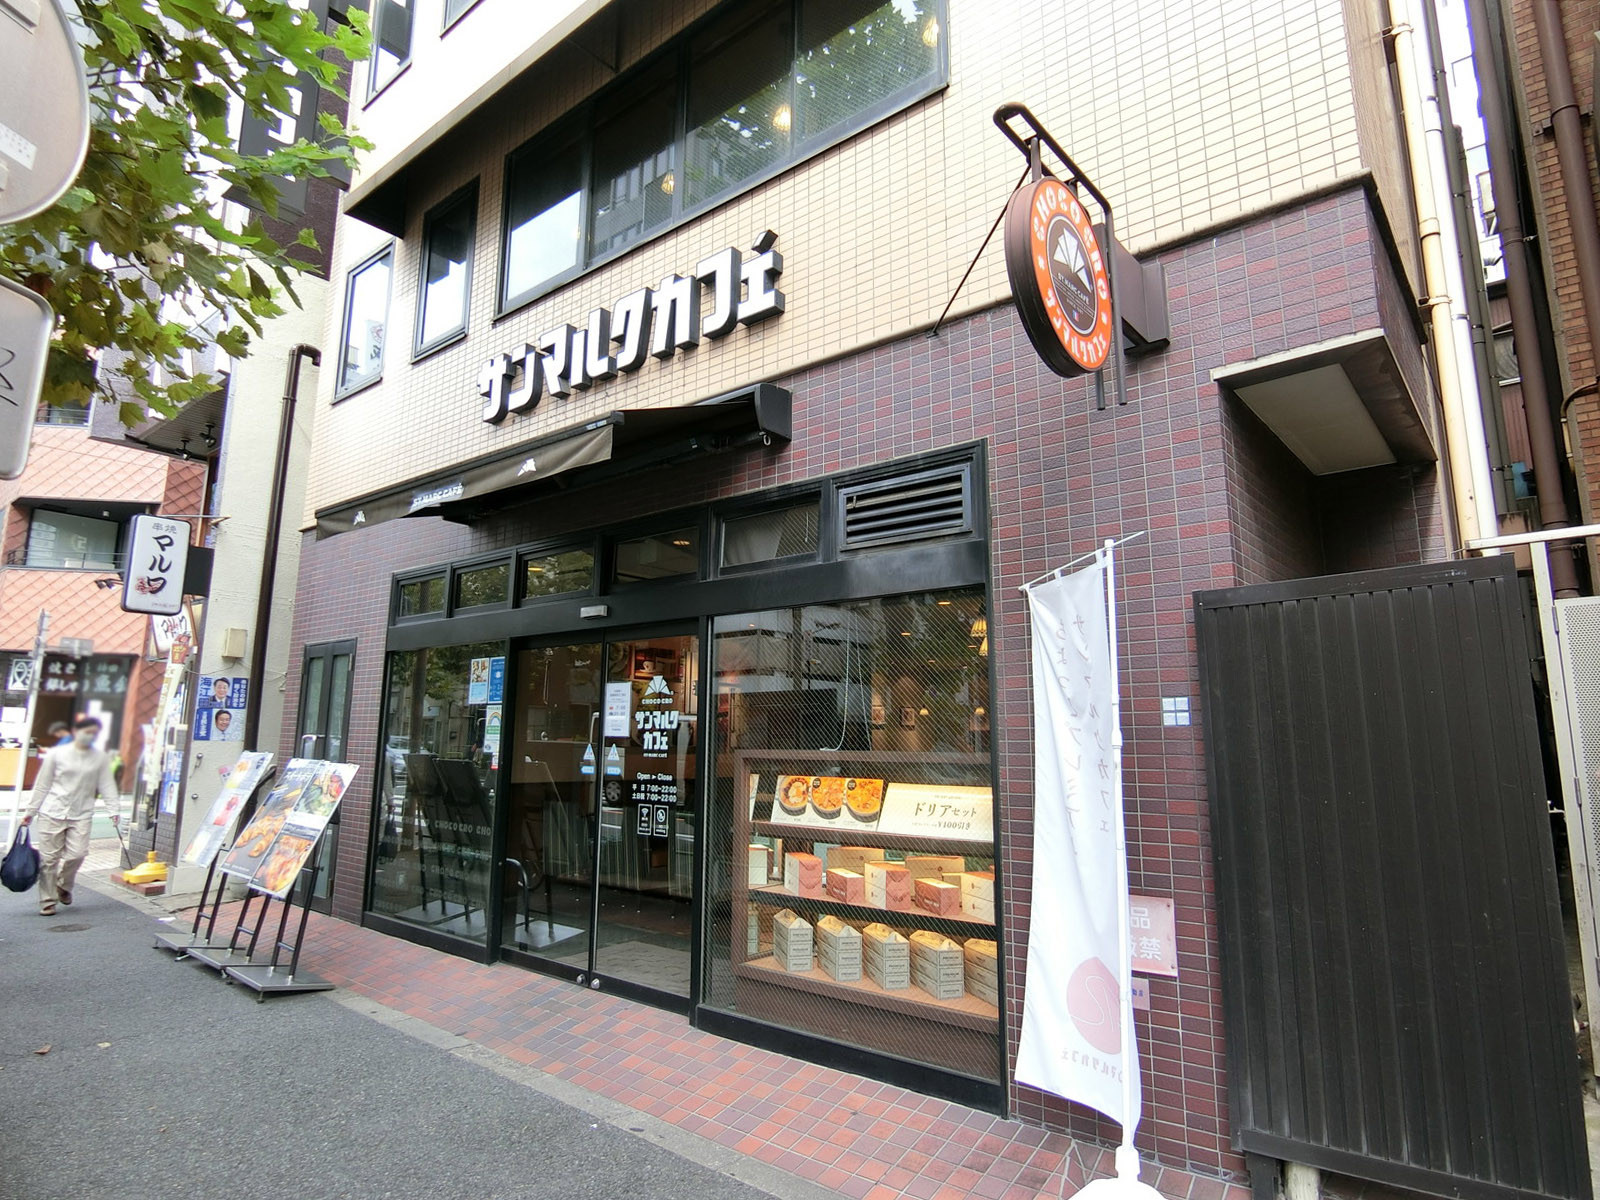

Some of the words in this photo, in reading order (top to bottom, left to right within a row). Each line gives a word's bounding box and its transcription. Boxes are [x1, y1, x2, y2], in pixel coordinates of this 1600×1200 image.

[1033, 186, 1081, 241] CHOCO
[1083, 226, 1108, 300] CRO
[477, 230, 785, 424] サンマルクカフェ
[1045, 287, 1107, 363] サンマルクカフェ
[152, 522, 178, 535] 串焼
[146, 534, 175, 595] マルワ
[635, 710, 680, 729] サンマルク
[643, 731, 669, 750] カフェ
[636, 772, 651, 781] Open
[657, 773, 673, 781] Close
[914, 802, 977, 818] ドリアセット
